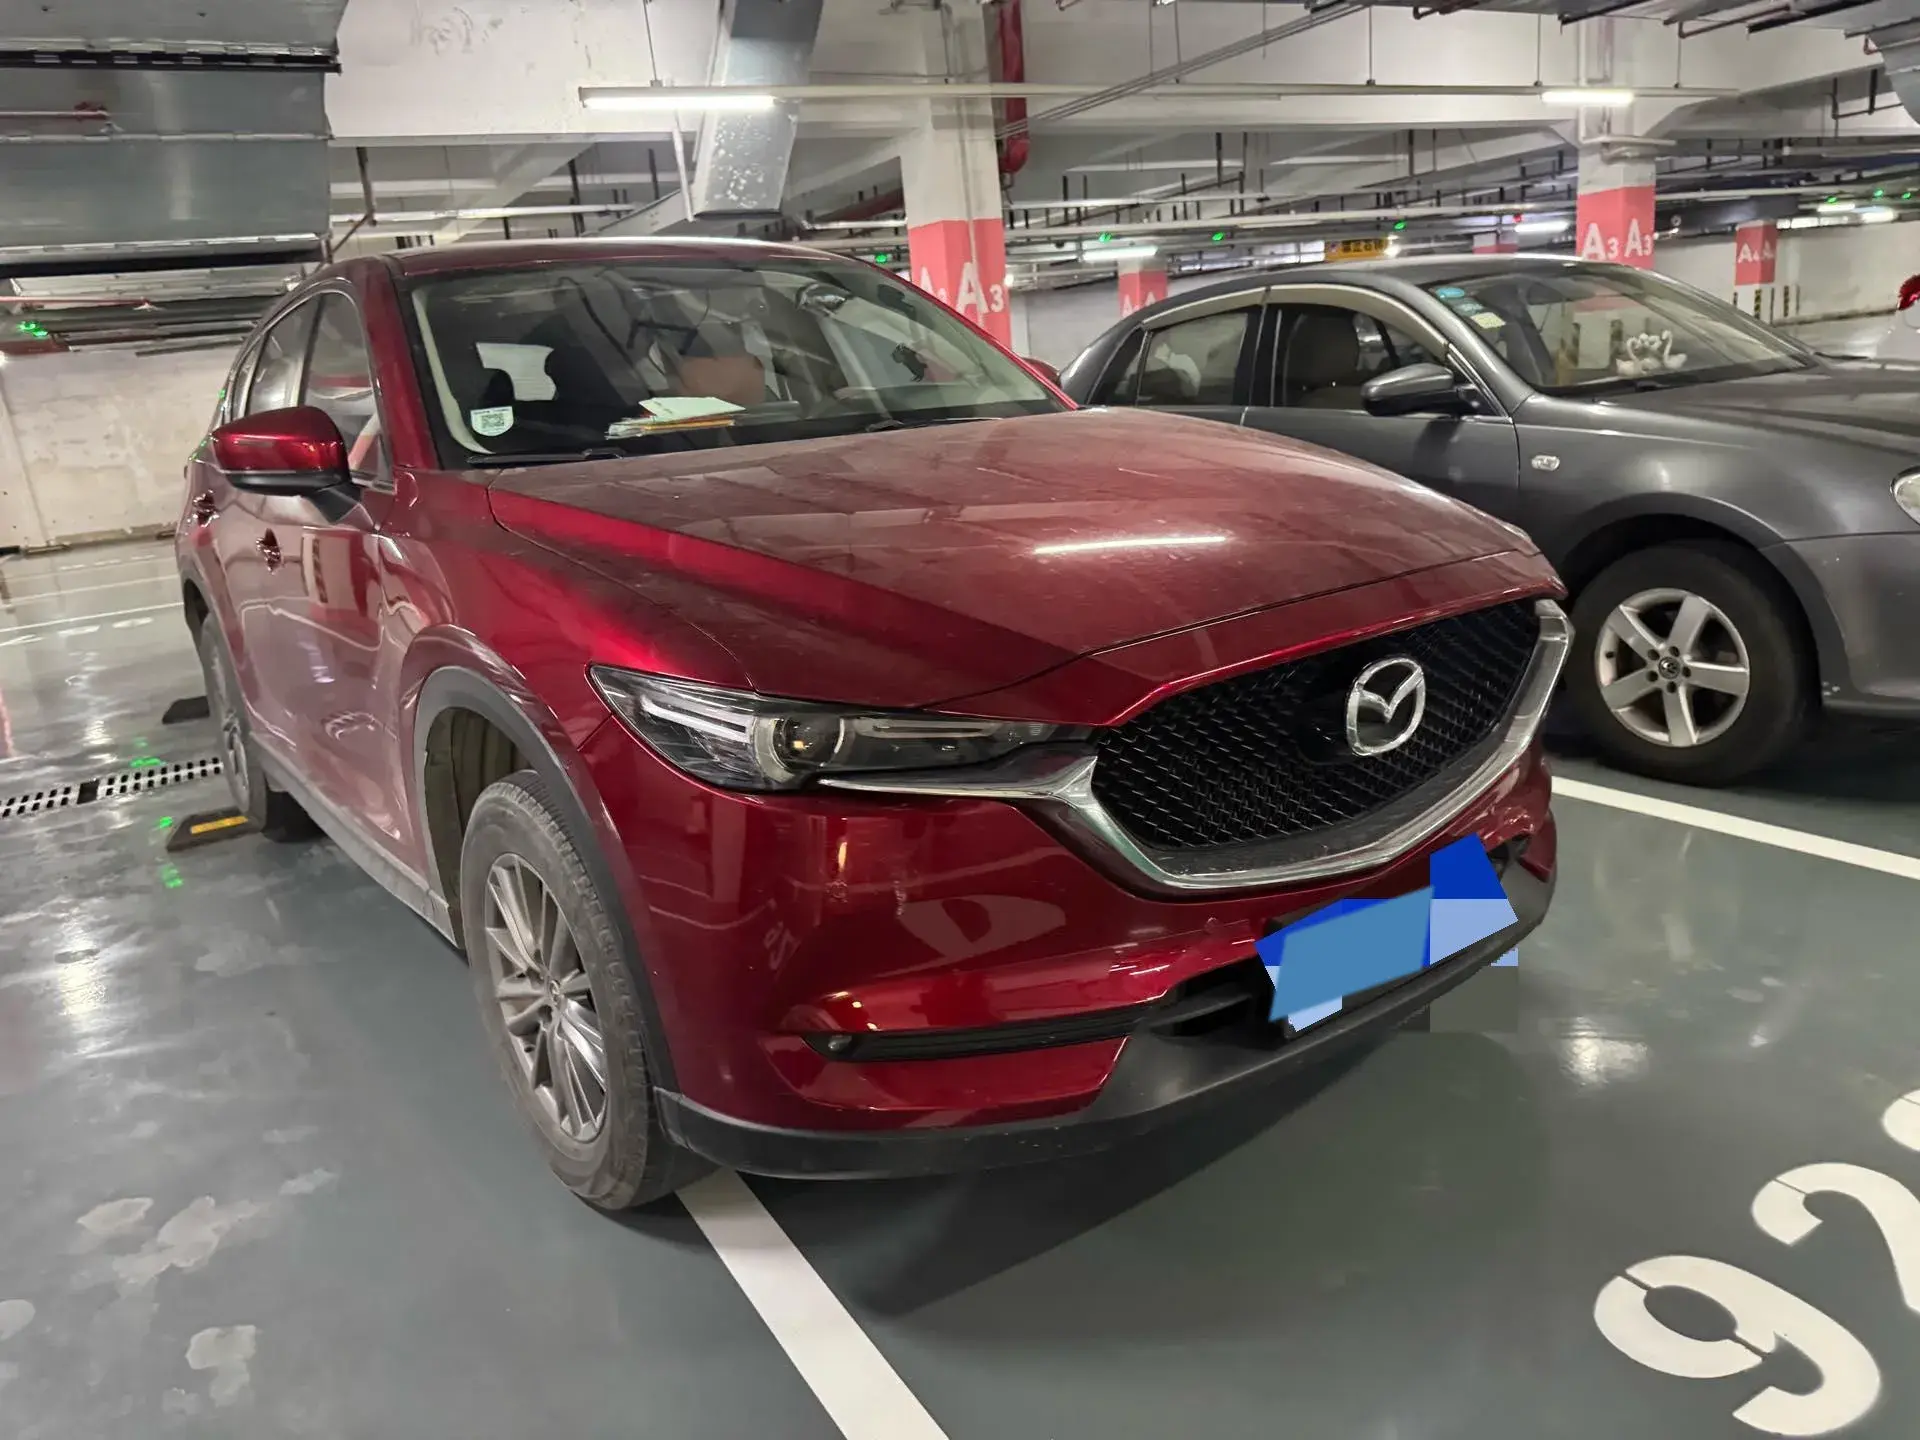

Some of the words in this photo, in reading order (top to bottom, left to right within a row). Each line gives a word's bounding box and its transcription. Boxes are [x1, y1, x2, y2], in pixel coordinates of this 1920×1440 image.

[1582, 222, 1619, 261] A3
[1624, 218, 1653, 258] A3
[956, 261, 1004, 314] A3
